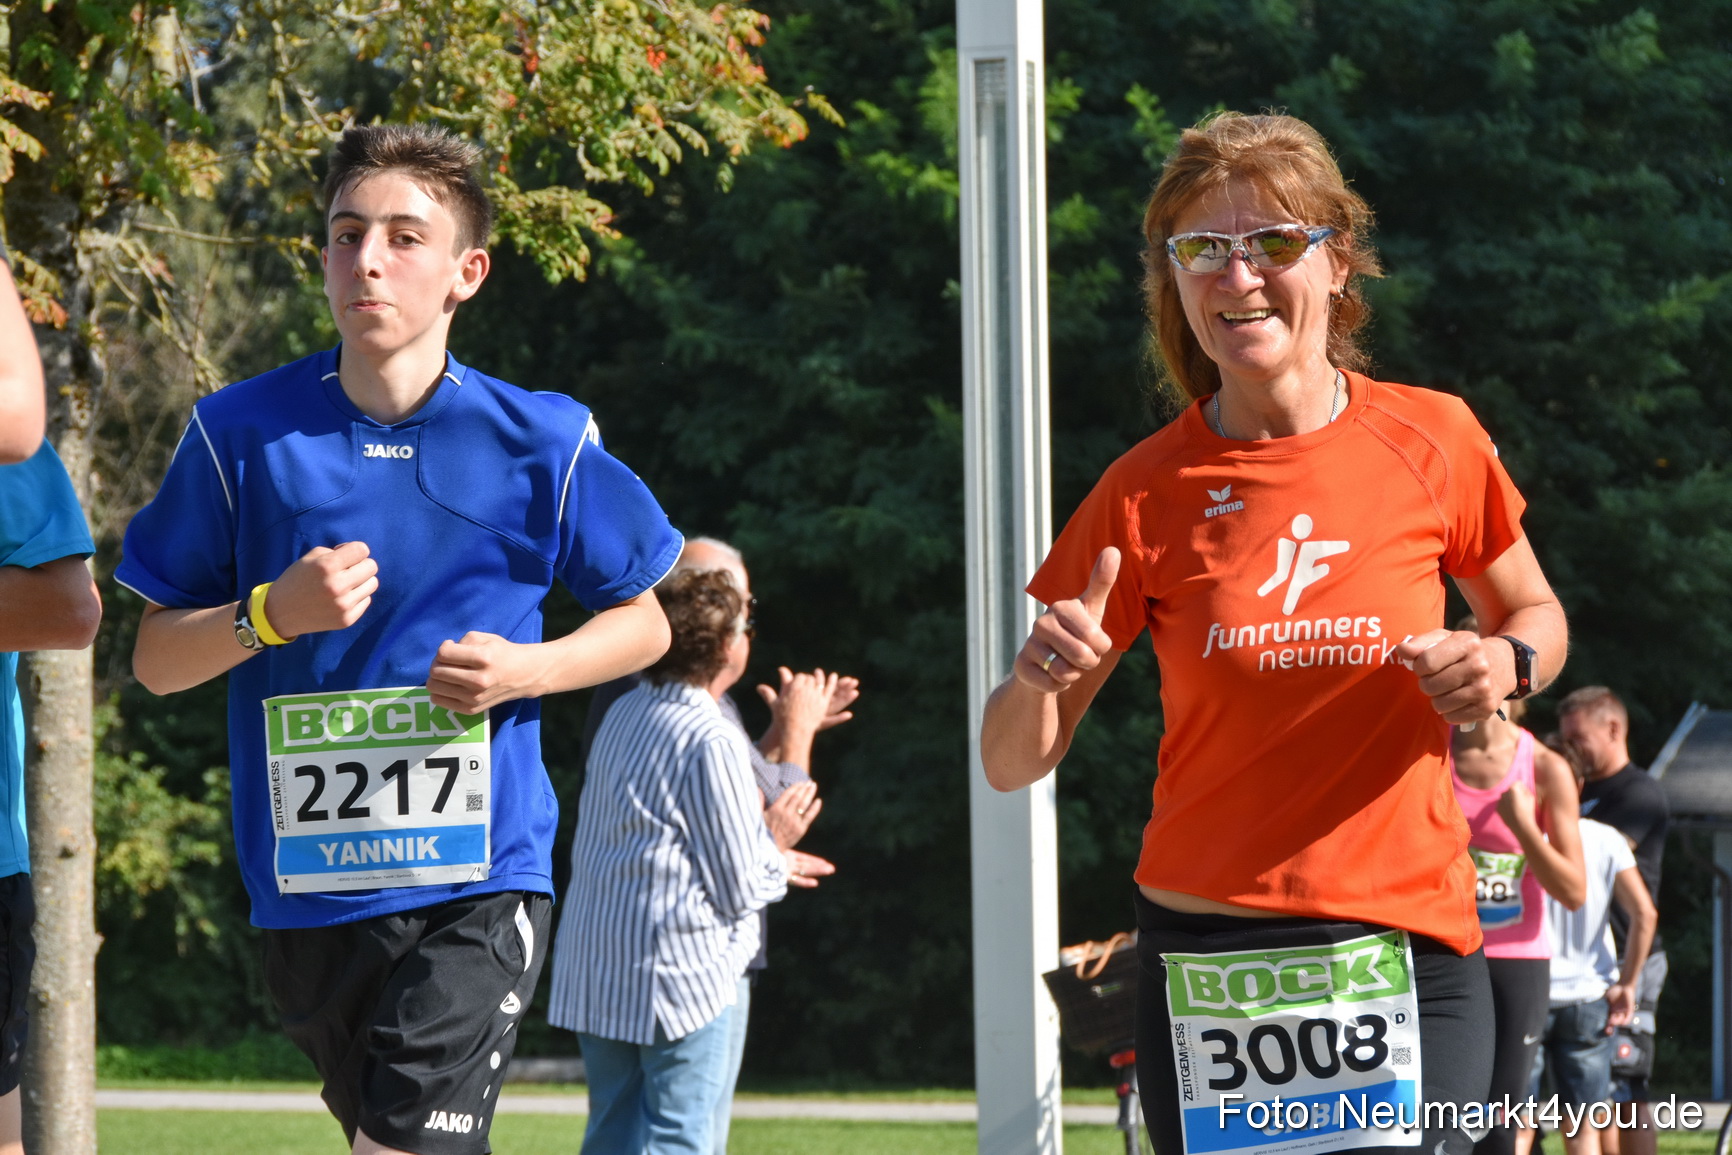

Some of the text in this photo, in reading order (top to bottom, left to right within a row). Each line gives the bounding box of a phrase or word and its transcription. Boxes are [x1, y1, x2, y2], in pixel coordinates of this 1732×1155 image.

[362, 443, 414, 460] JAKO
[1204, 500, 1244, 518] erima
[1202, 616, 1382, 659] funrunners
[1258, 637, 1404, 671] neumark
[284, 698, 463, 744] BOCK
[469, 759, 479, 771] D
[294, 756, 461, 823] 2217
[317, 835, 442, 867] YANNIK
[1184, 947, 1386, 1006] BOCK
[1395, 1012, 1406, 1025] D
[1200, 1014, 1389, 1091] 3008
[424, 1110, 473, 1134] JAKO
